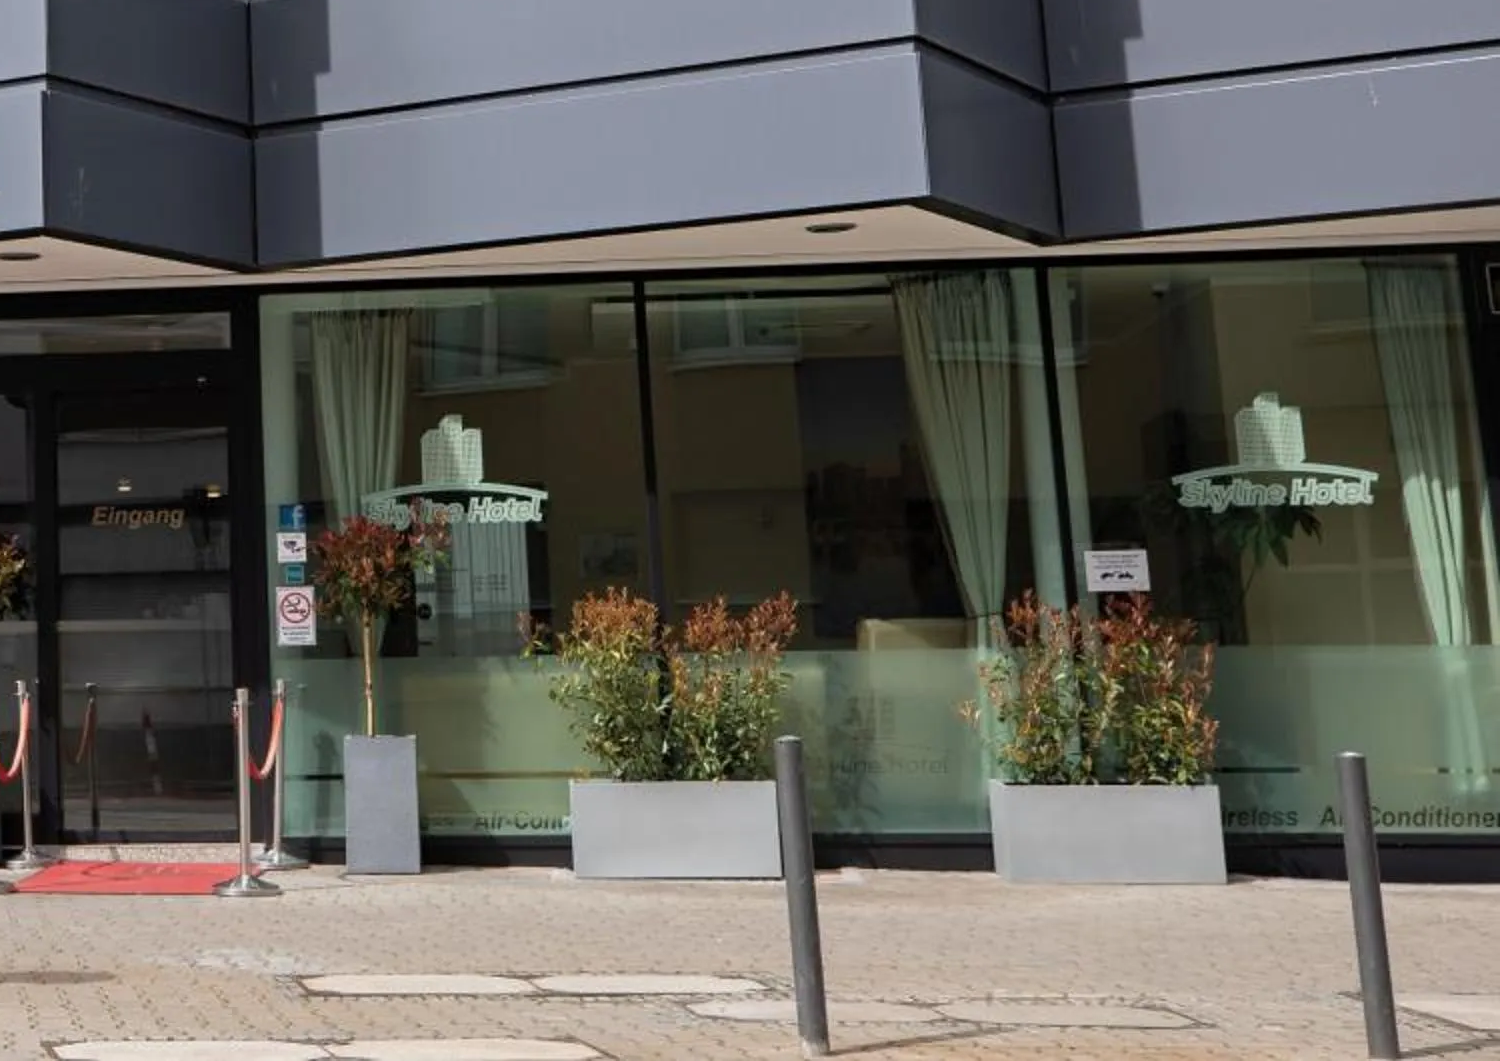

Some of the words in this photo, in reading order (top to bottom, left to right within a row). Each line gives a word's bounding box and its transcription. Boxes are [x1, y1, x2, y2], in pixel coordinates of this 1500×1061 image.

[1178, 478, 1287, 514] Skyline
[1289, 476, 1375, 507] Hotel
[91, 505, 185, 530] Eingang
[467, 495, 543, 524] Hotel
[1221, 805, 1299, 828] ireless
